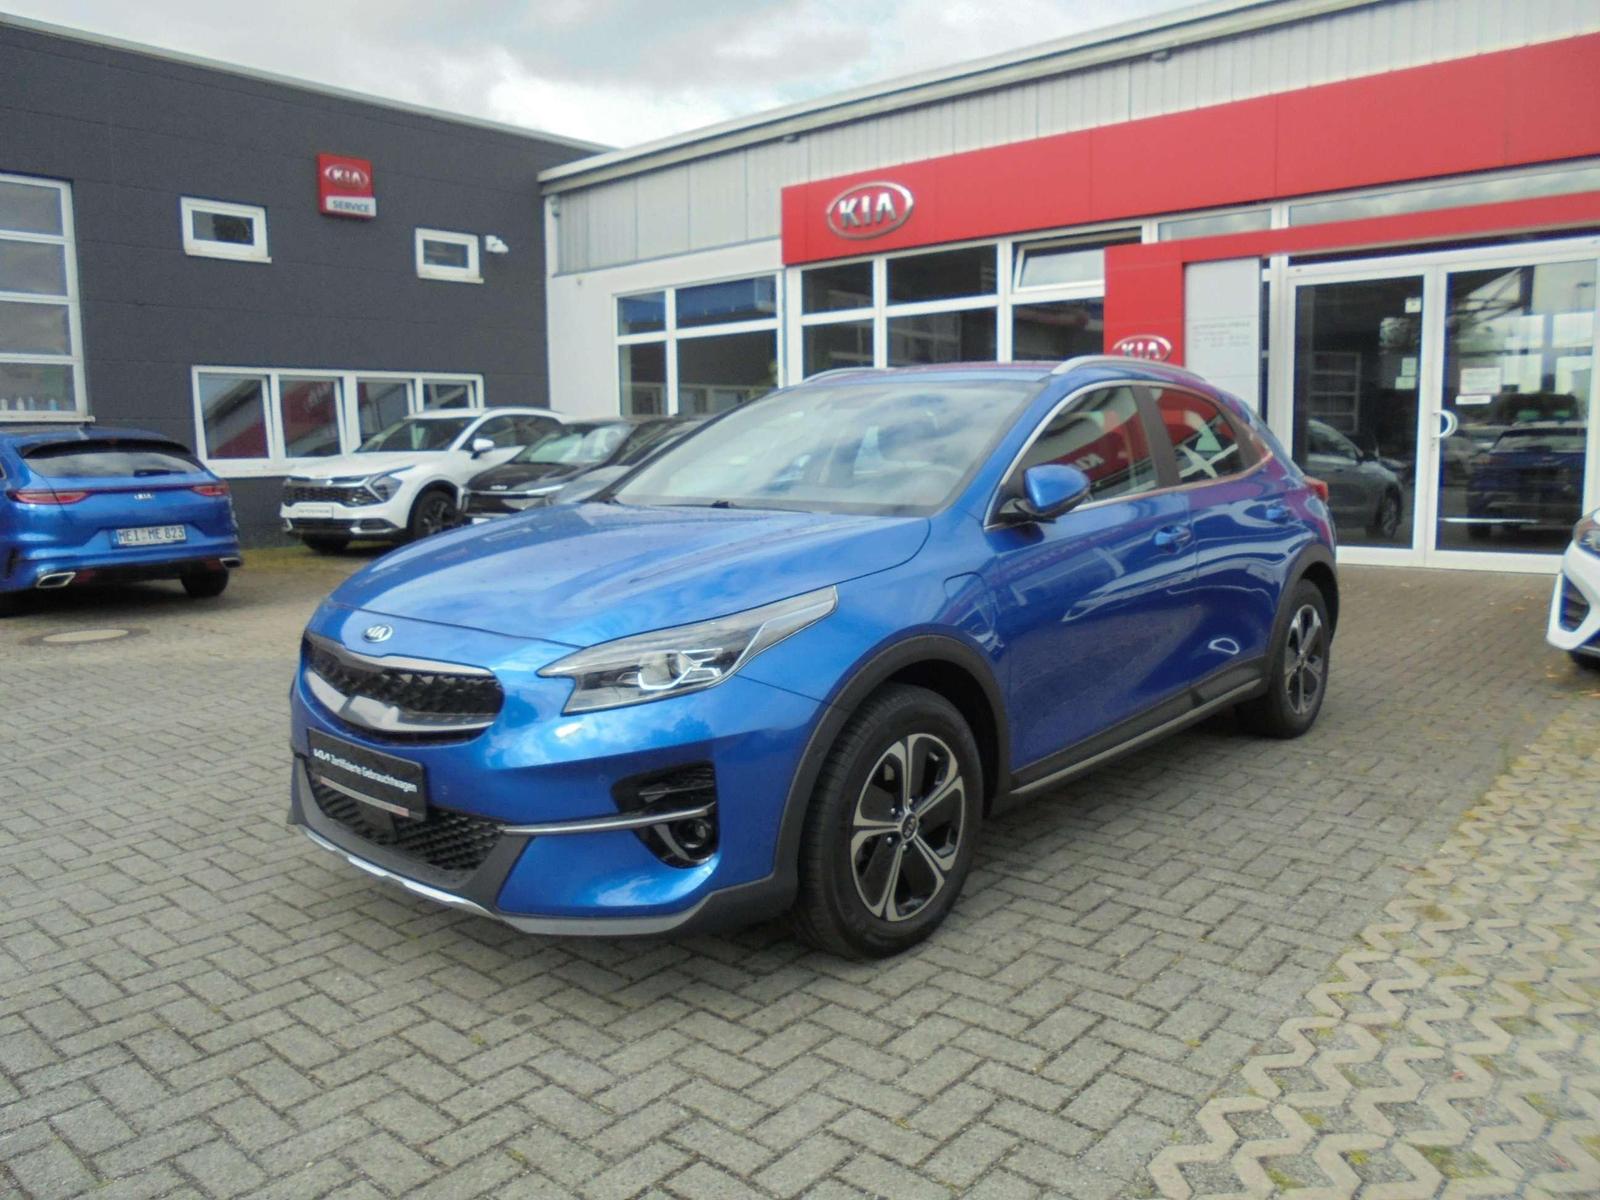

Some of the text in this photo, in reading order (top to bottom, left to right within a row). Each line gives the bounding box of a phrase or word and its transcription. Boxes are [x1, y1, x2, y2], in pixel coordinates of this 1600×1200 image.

[333, 168, 362, 184] KIA
[332, 199, 370, 213] SERVICE
[839, 192, 897, 228] KIA
[1121, 341, 1161, 361] KIA
